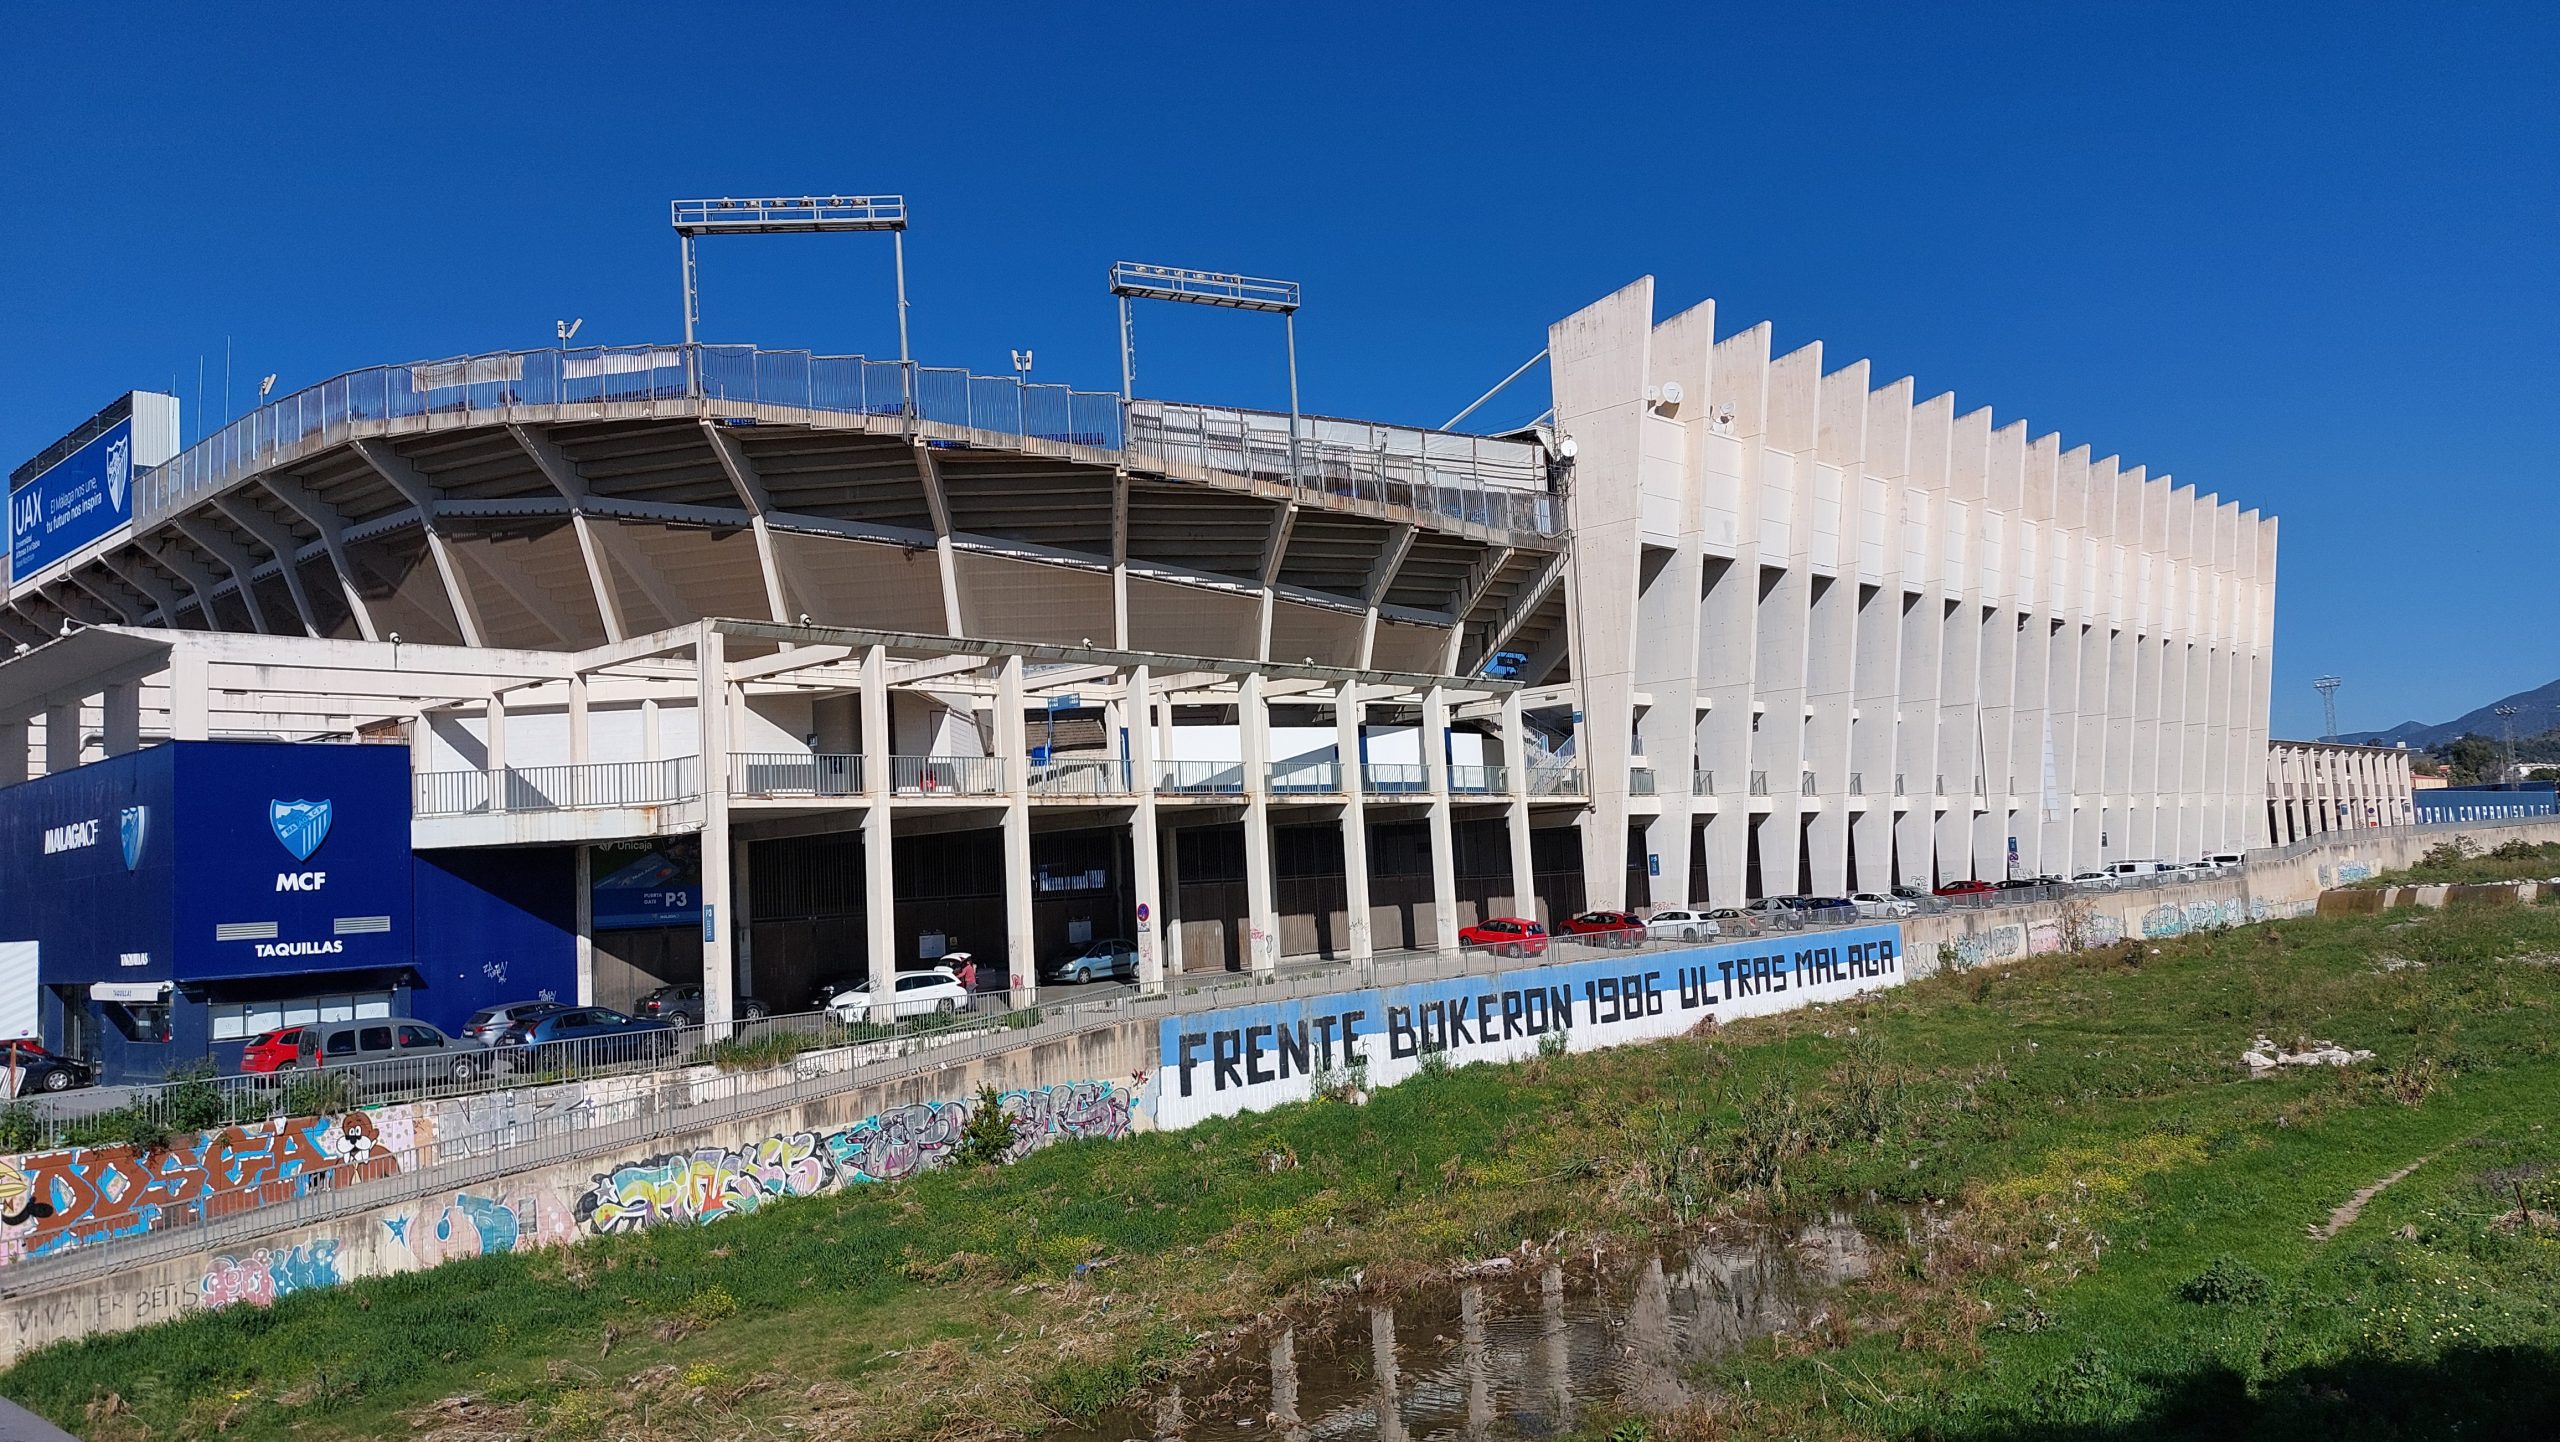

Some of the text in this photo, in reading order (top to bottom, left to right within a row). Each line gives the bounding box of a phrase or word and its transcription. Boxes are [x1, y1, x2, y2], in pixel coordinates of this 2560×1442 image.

[74, 483, 85, 500] nos
[15, 486, 43, 536] UAX
[46, 491, 102, 534] tu futuro nos inspira
[617, 840, 653, 852] Unicaja
[275, 871, 326, 893] MCF
[665, 891, 688, 908] P3
[255, 940, 344, 958] TAQUILLAS
[1178, 1009, 1368, 1098] FRENTE
[1387, 982, 1573, 1061] BOKERON
[1585, 970, 1663, 1025] 1986
[1678, 954, 1788, 1010] ULTRAS
[1795, 939, 1895, 988] MALAGA
